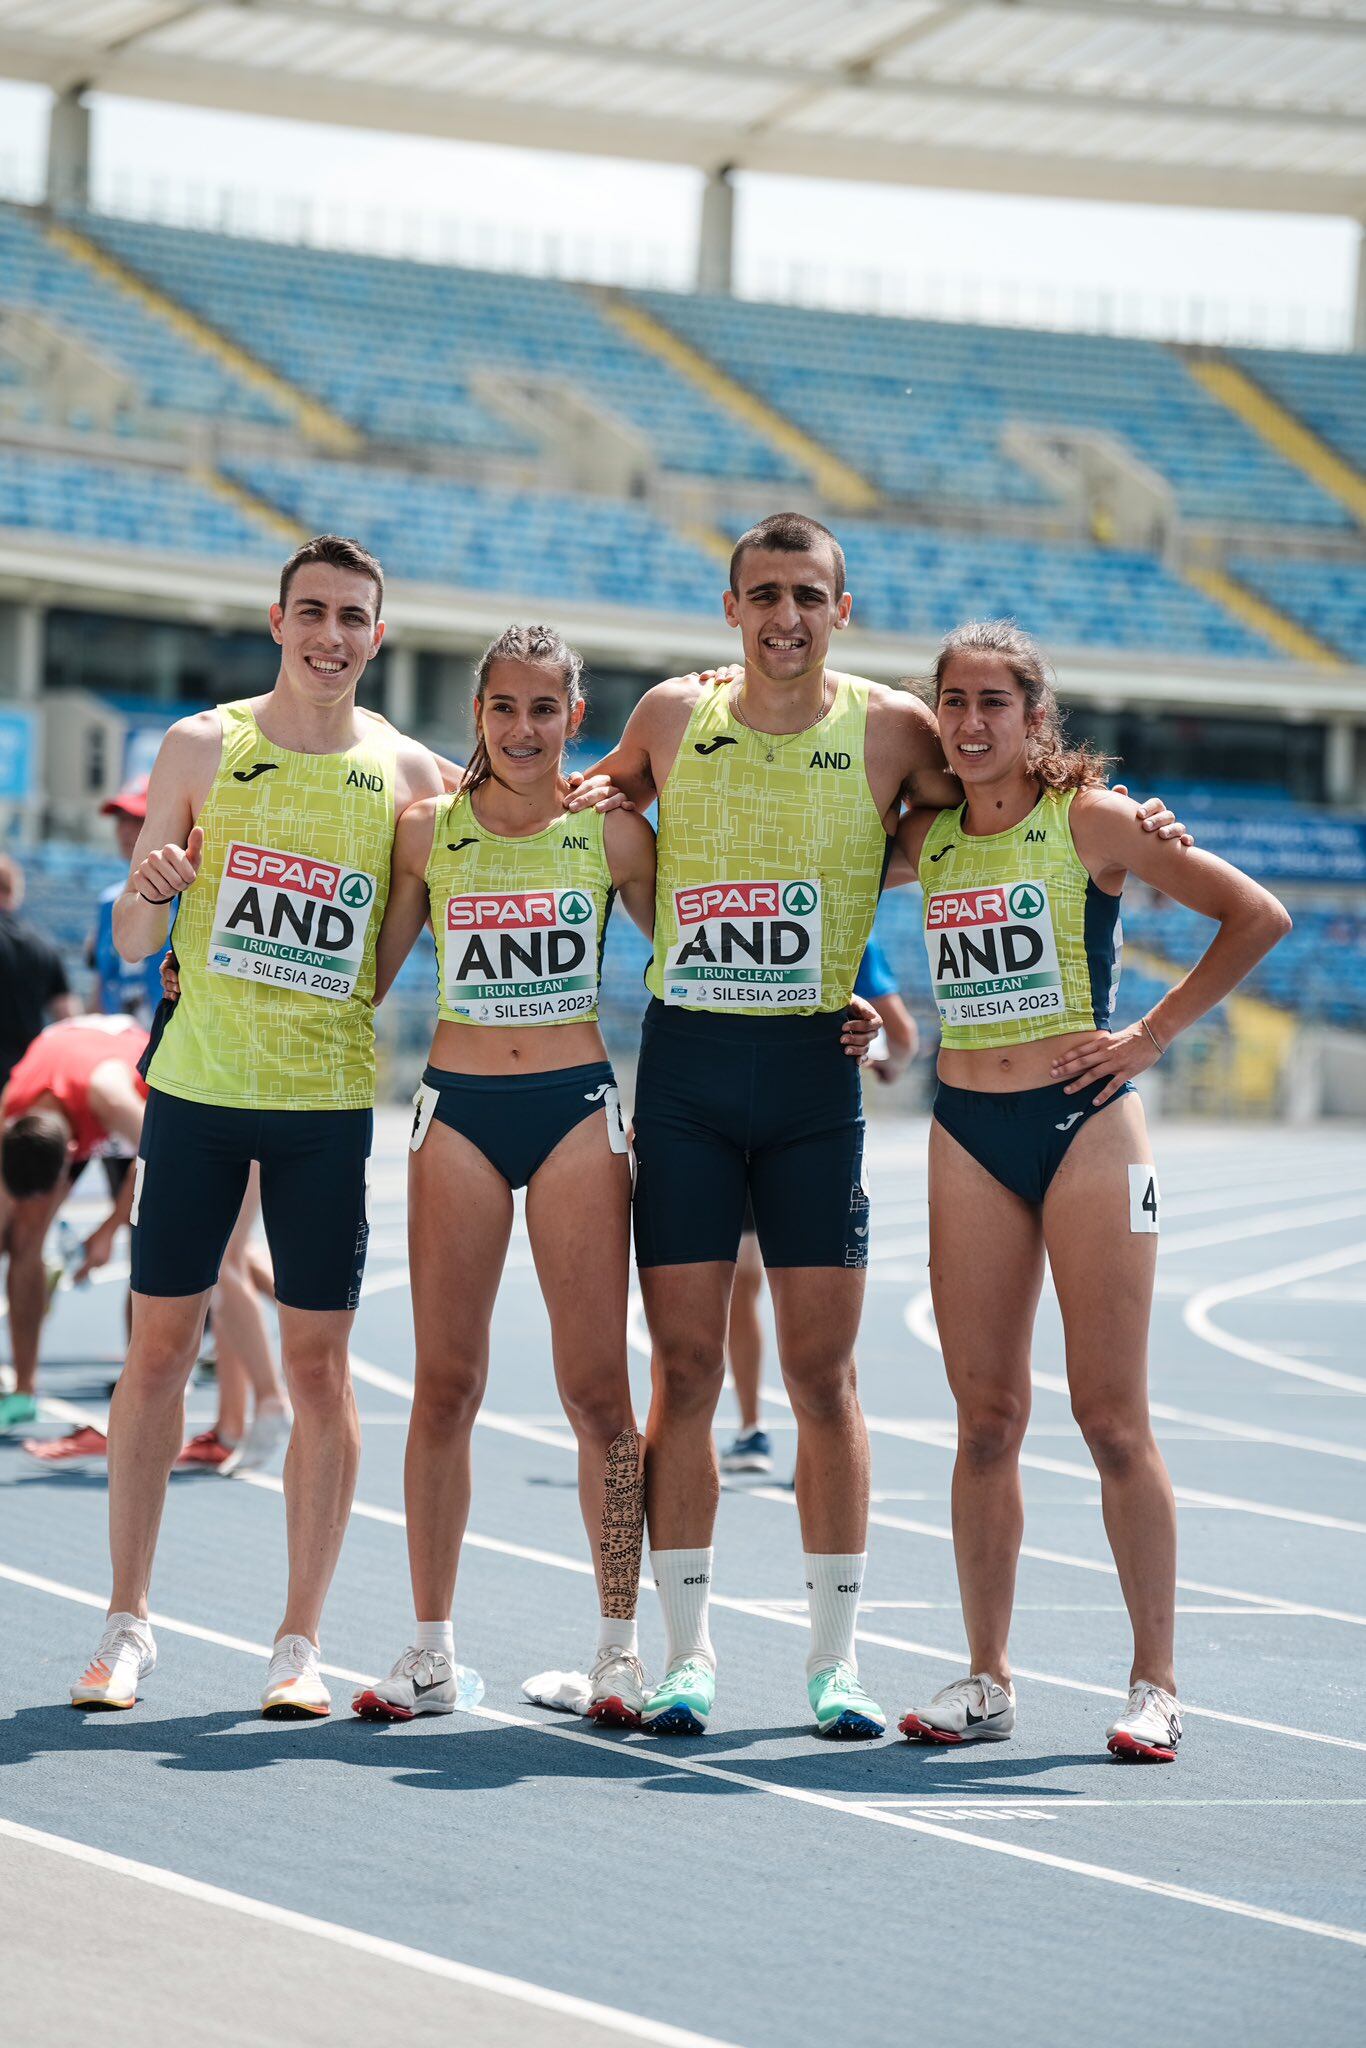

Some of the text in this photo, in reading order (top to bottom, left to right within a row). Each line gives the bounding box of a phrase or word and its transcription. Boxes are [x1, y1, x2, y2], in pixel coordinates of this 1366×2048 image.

[809, 751, 851, 770] AND
[346, 770, 383, 792] AND
[1024, 829, 1046, 842] AN
[231, 851, 336, 896] SPAR
[450, 898, 553, 926] SPAR
[680, 888, 776, 920] SPAR
[929, 894, 1004, 925] SPAR
[225, 887, 355, 951] AND
[249, 941, 279, 957] RUN
[456, 930, 586, 981] AND
[675, 921, 810, 965] AND
[937, 925, 1044, 980] AND
[253, 961, 350, 994] SILESIA 2023
[704, 968, 735, 979] RUN
[485, 985, 516, 997] RUN
[713, 988, 817, 1001] SILESIA 2023
[954, 984, 976, 996] RUN
[494, 995, 593, 1018] SILESIA 2023
[960, 993, 1059, 1019] SILESIA 2023
[1142, 1177, 1157, 1222] 4
